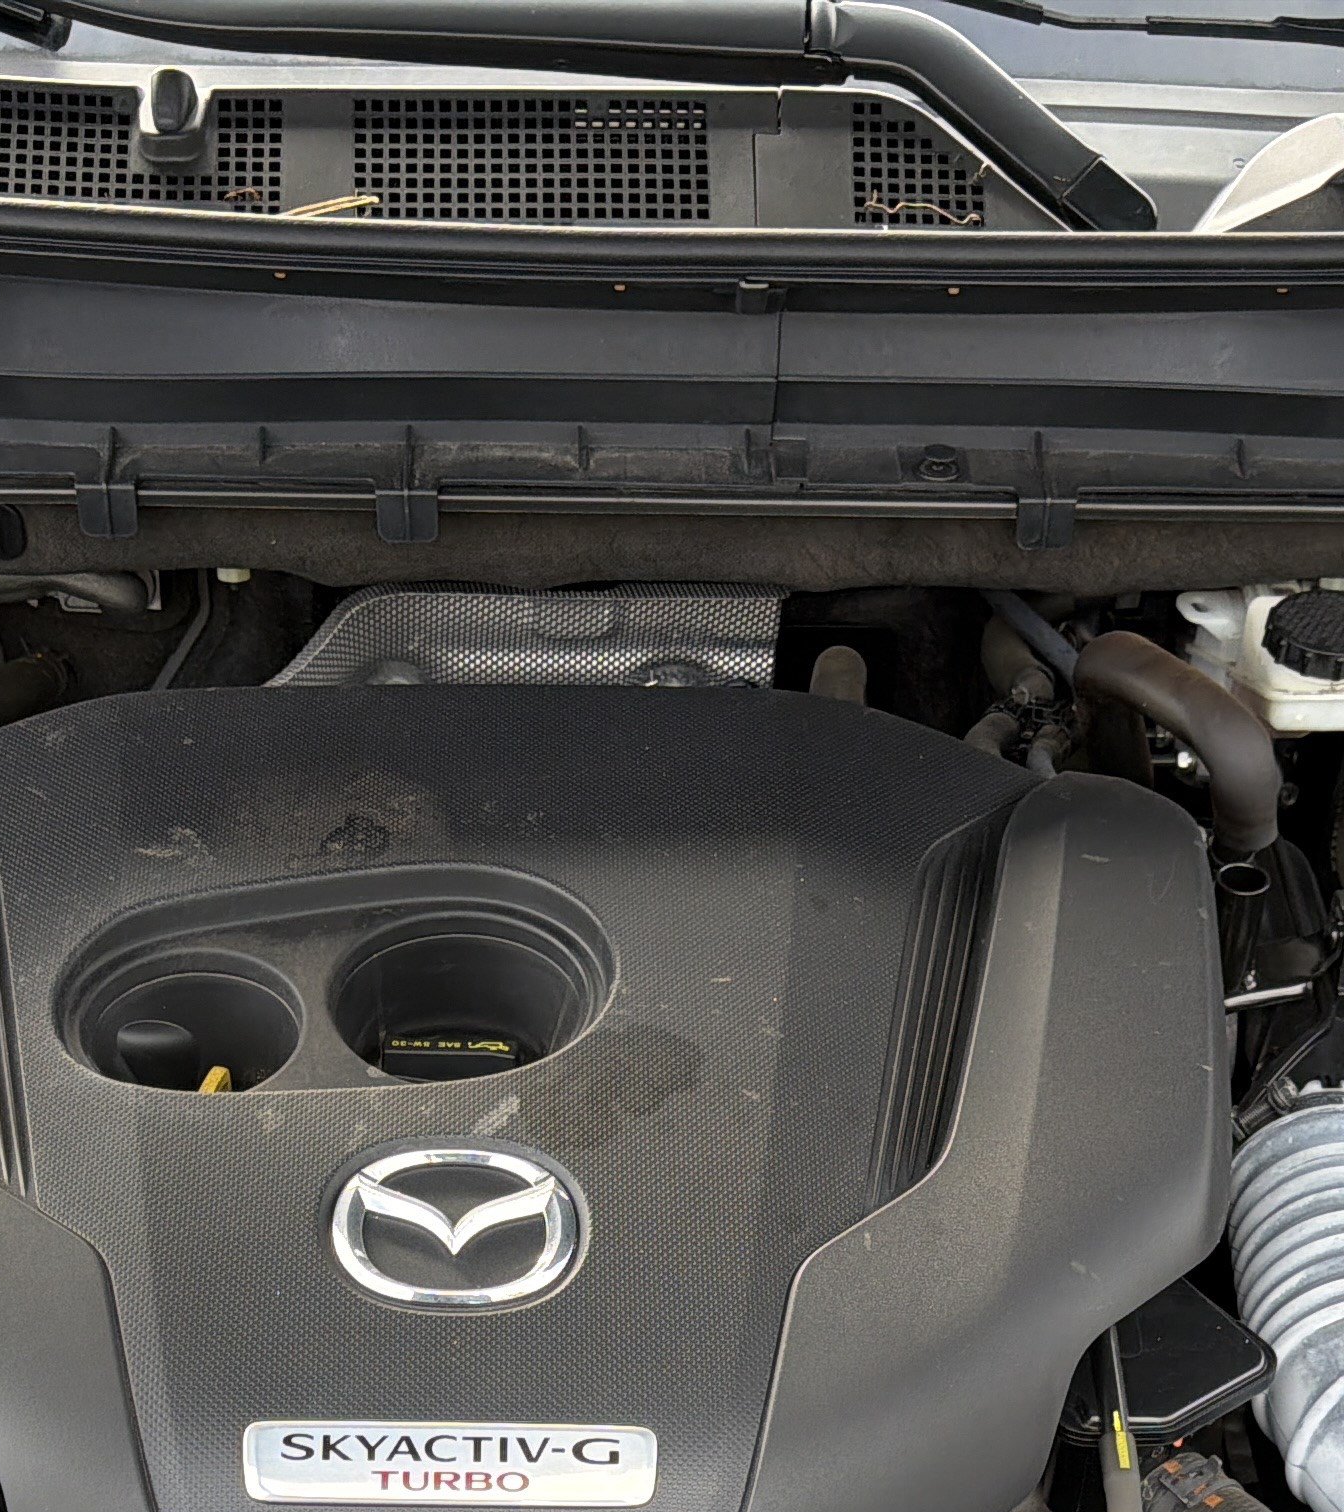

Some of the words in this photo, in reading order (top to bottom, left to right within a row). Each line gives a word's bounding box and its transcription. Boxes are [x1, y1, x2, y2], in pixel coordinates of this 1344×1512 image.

[390, 1040, 432, 1048] 5W-30
[438, 1040, 462, 1049] SAE
[281, 1432, 621, 1466] SKYACTIV-G
[371, 1471, 530, 1493] TURBO
